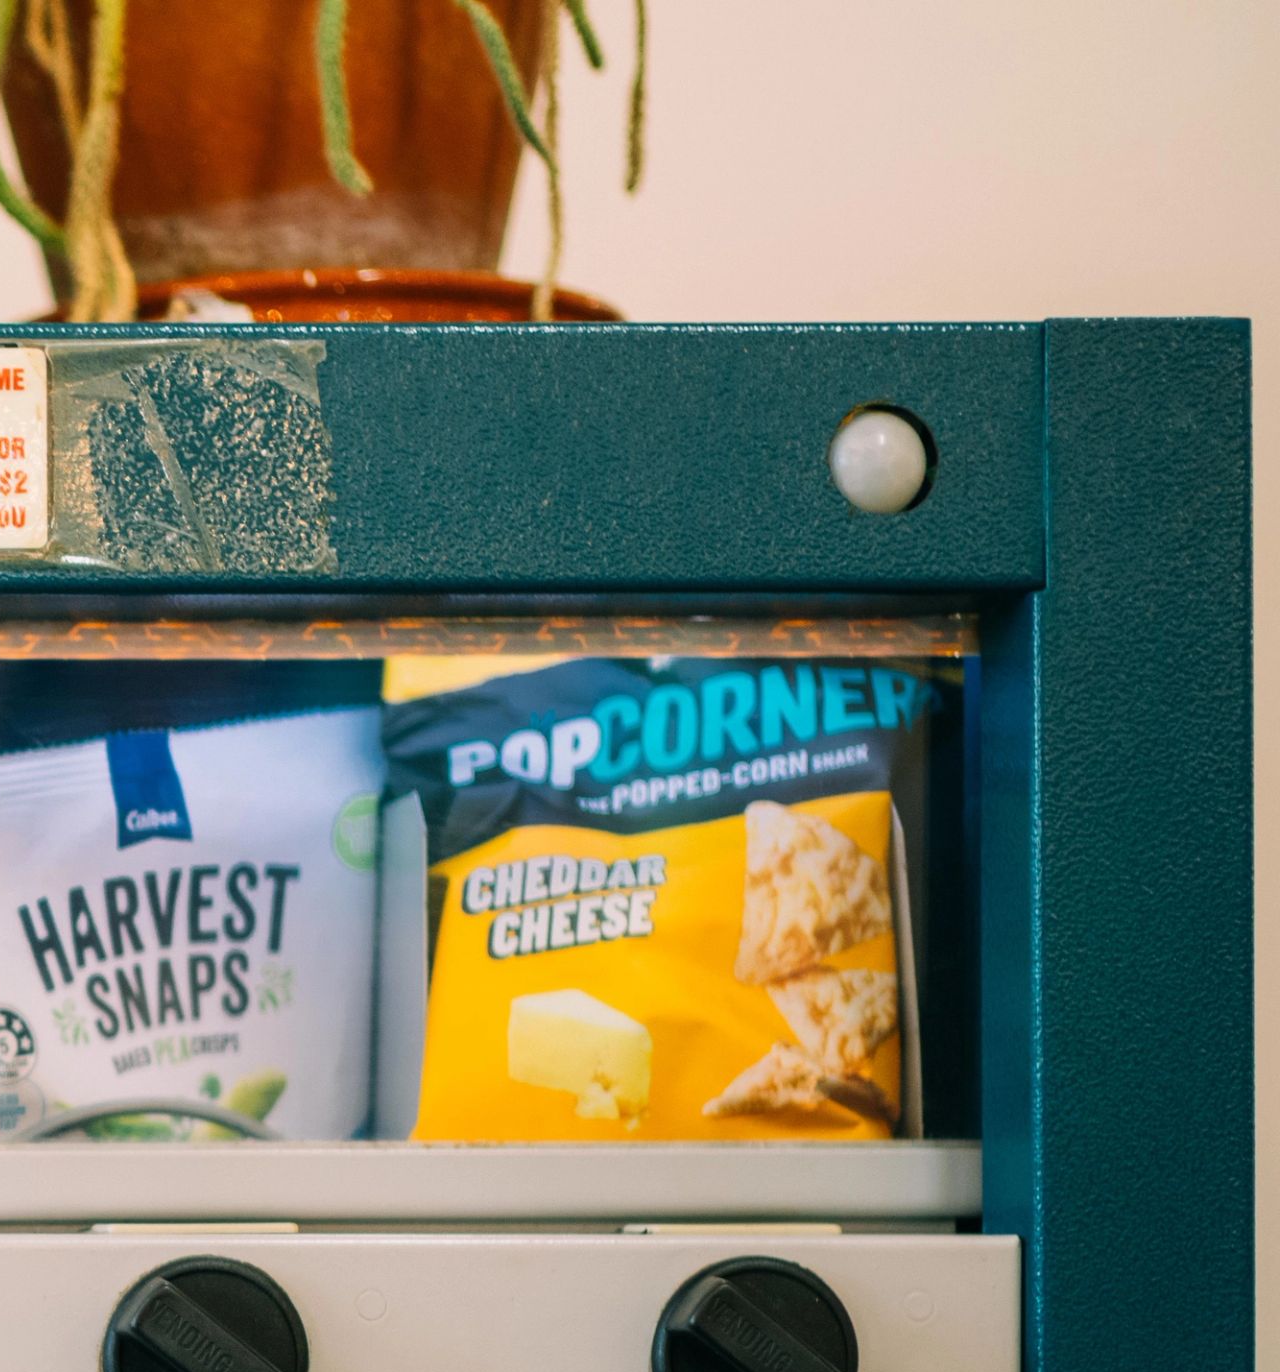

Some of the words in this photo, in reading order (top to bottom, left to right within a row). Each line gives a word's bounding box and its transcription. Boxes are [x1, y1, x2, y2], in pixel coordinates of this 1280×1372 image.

[0, 470, 28, 497] $2
[612, 749, 809, 813] POPPED-CORN
[463, 855, 667, 914] CHEDDAR
[18, 862, 301, 992] HARVEST
[489, 890, 658, 959] CHEESE
[86, 951, 250, 1041] SNAPS
